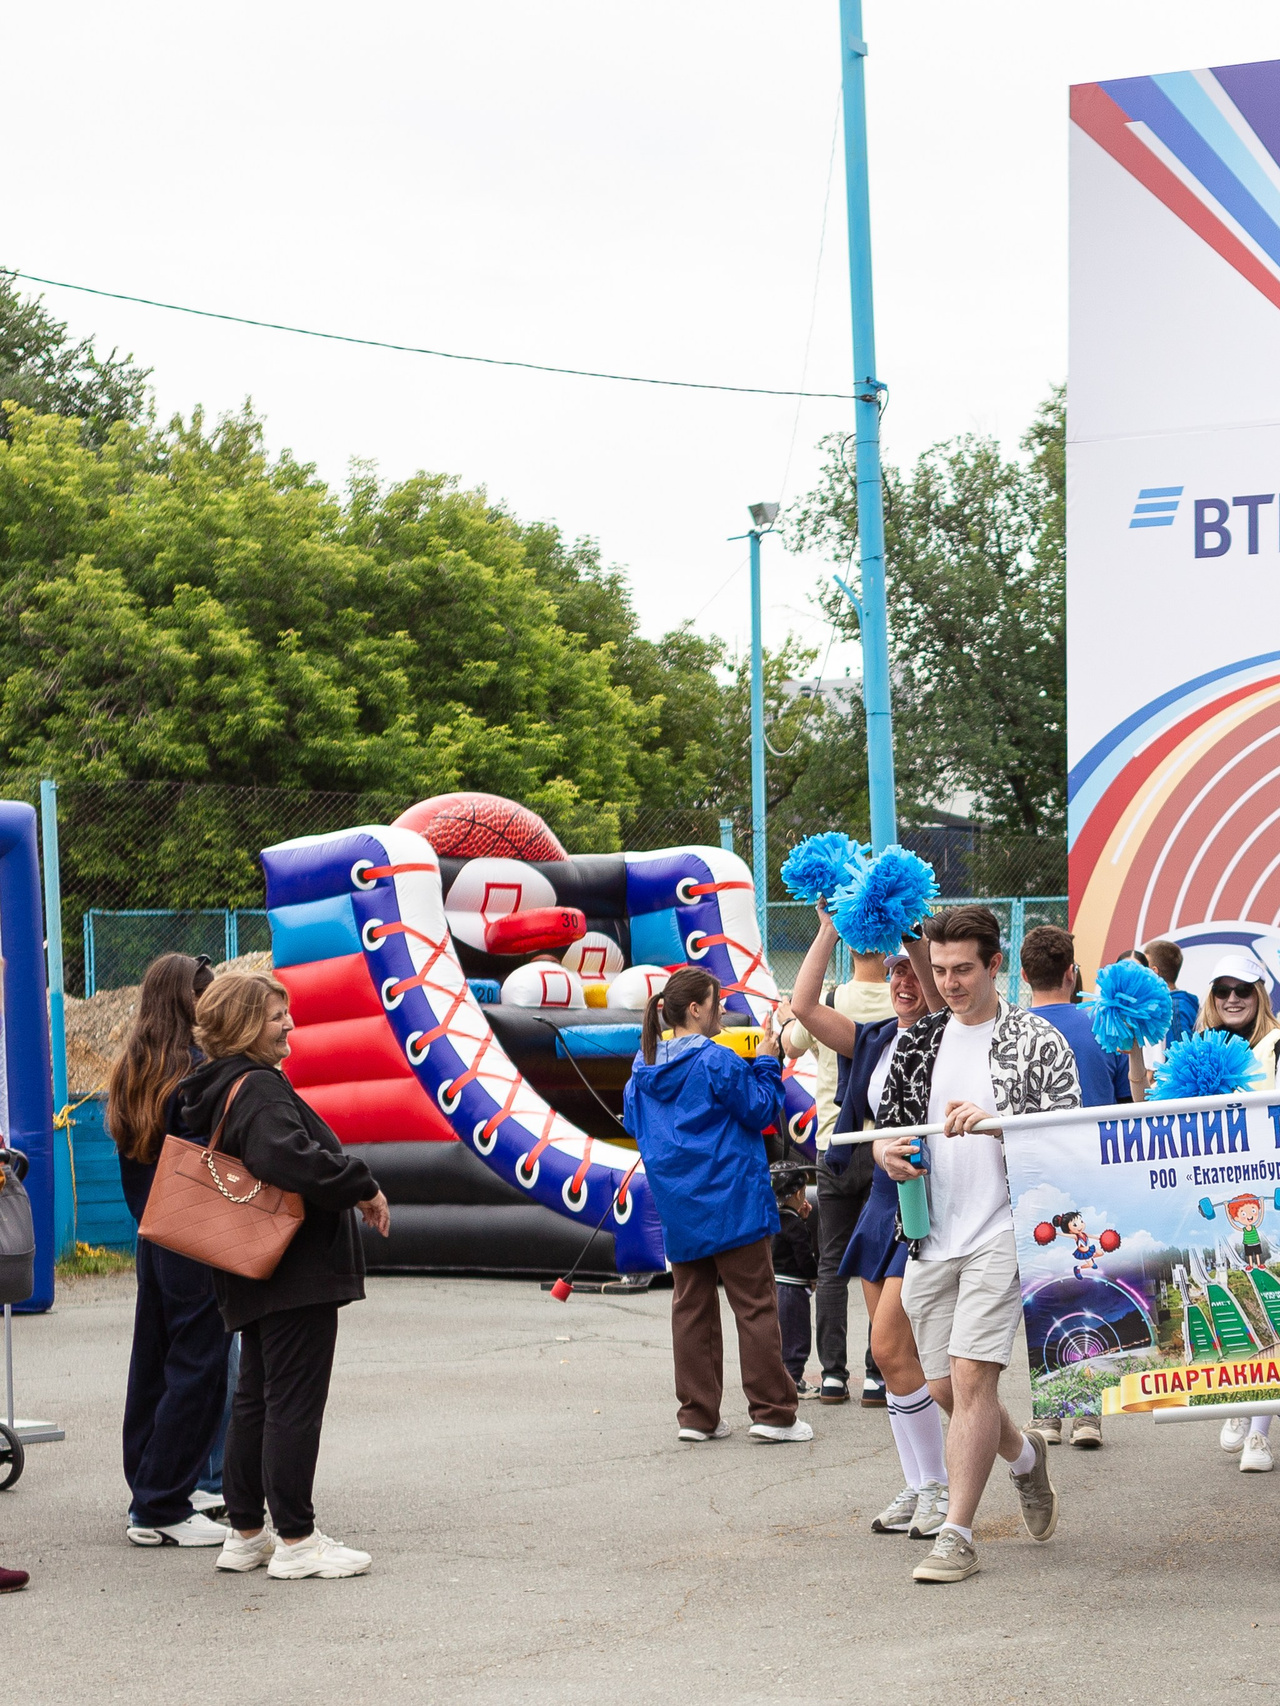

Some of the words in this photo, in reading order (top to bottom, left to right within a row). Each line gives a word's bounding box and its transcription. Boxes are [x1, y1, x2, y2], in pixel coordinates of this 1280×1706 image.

[561, 912, 579, 929] 30
[475, 986, 494, 1004] 20
[1097, 1102, 1250, 1165] НИЖНИЙ
[1149, 1167, 1178, 1190] РОО
